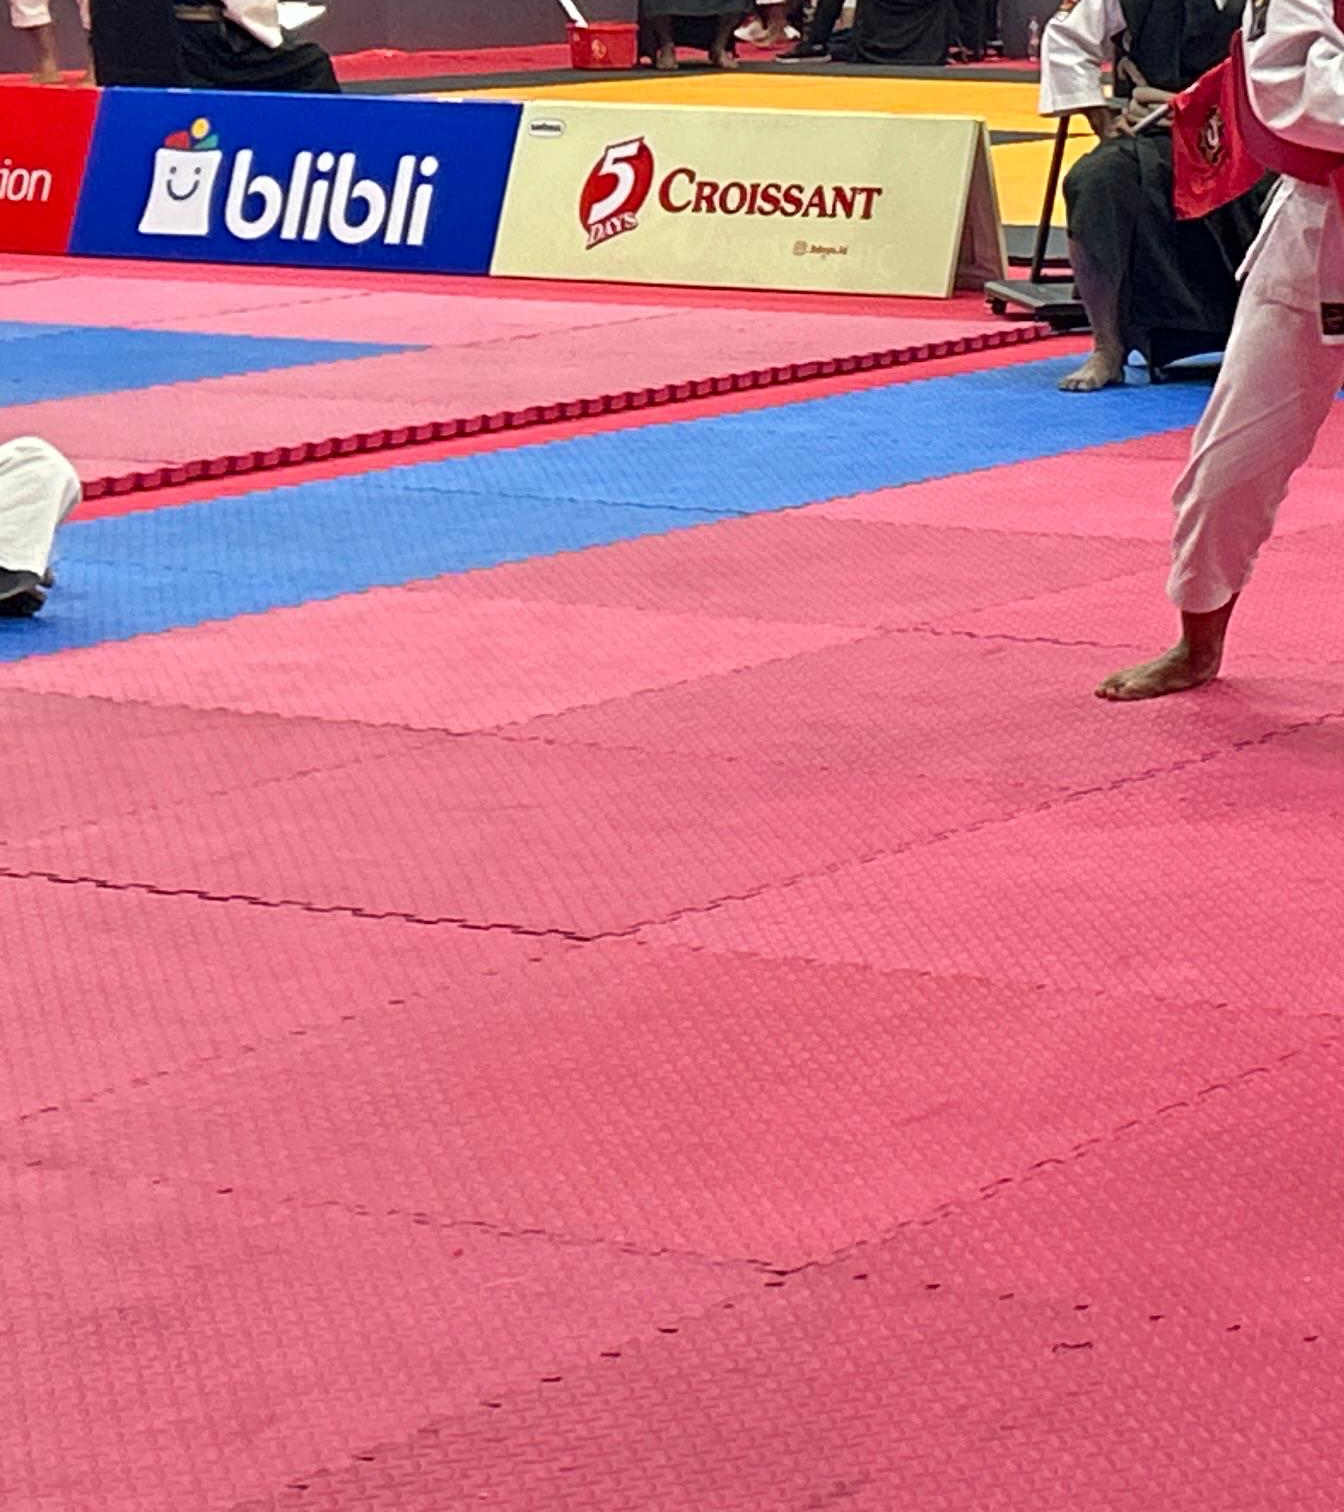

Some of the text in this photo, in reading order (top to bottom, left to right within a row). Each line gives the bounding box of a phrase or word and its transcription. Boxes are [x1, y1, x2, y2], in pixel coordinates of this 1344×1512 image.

[224, 148, 440, 247] blibli
[657, 166, 883, 221] CROISSANT
[588, 211, 639, 245] DAYS
